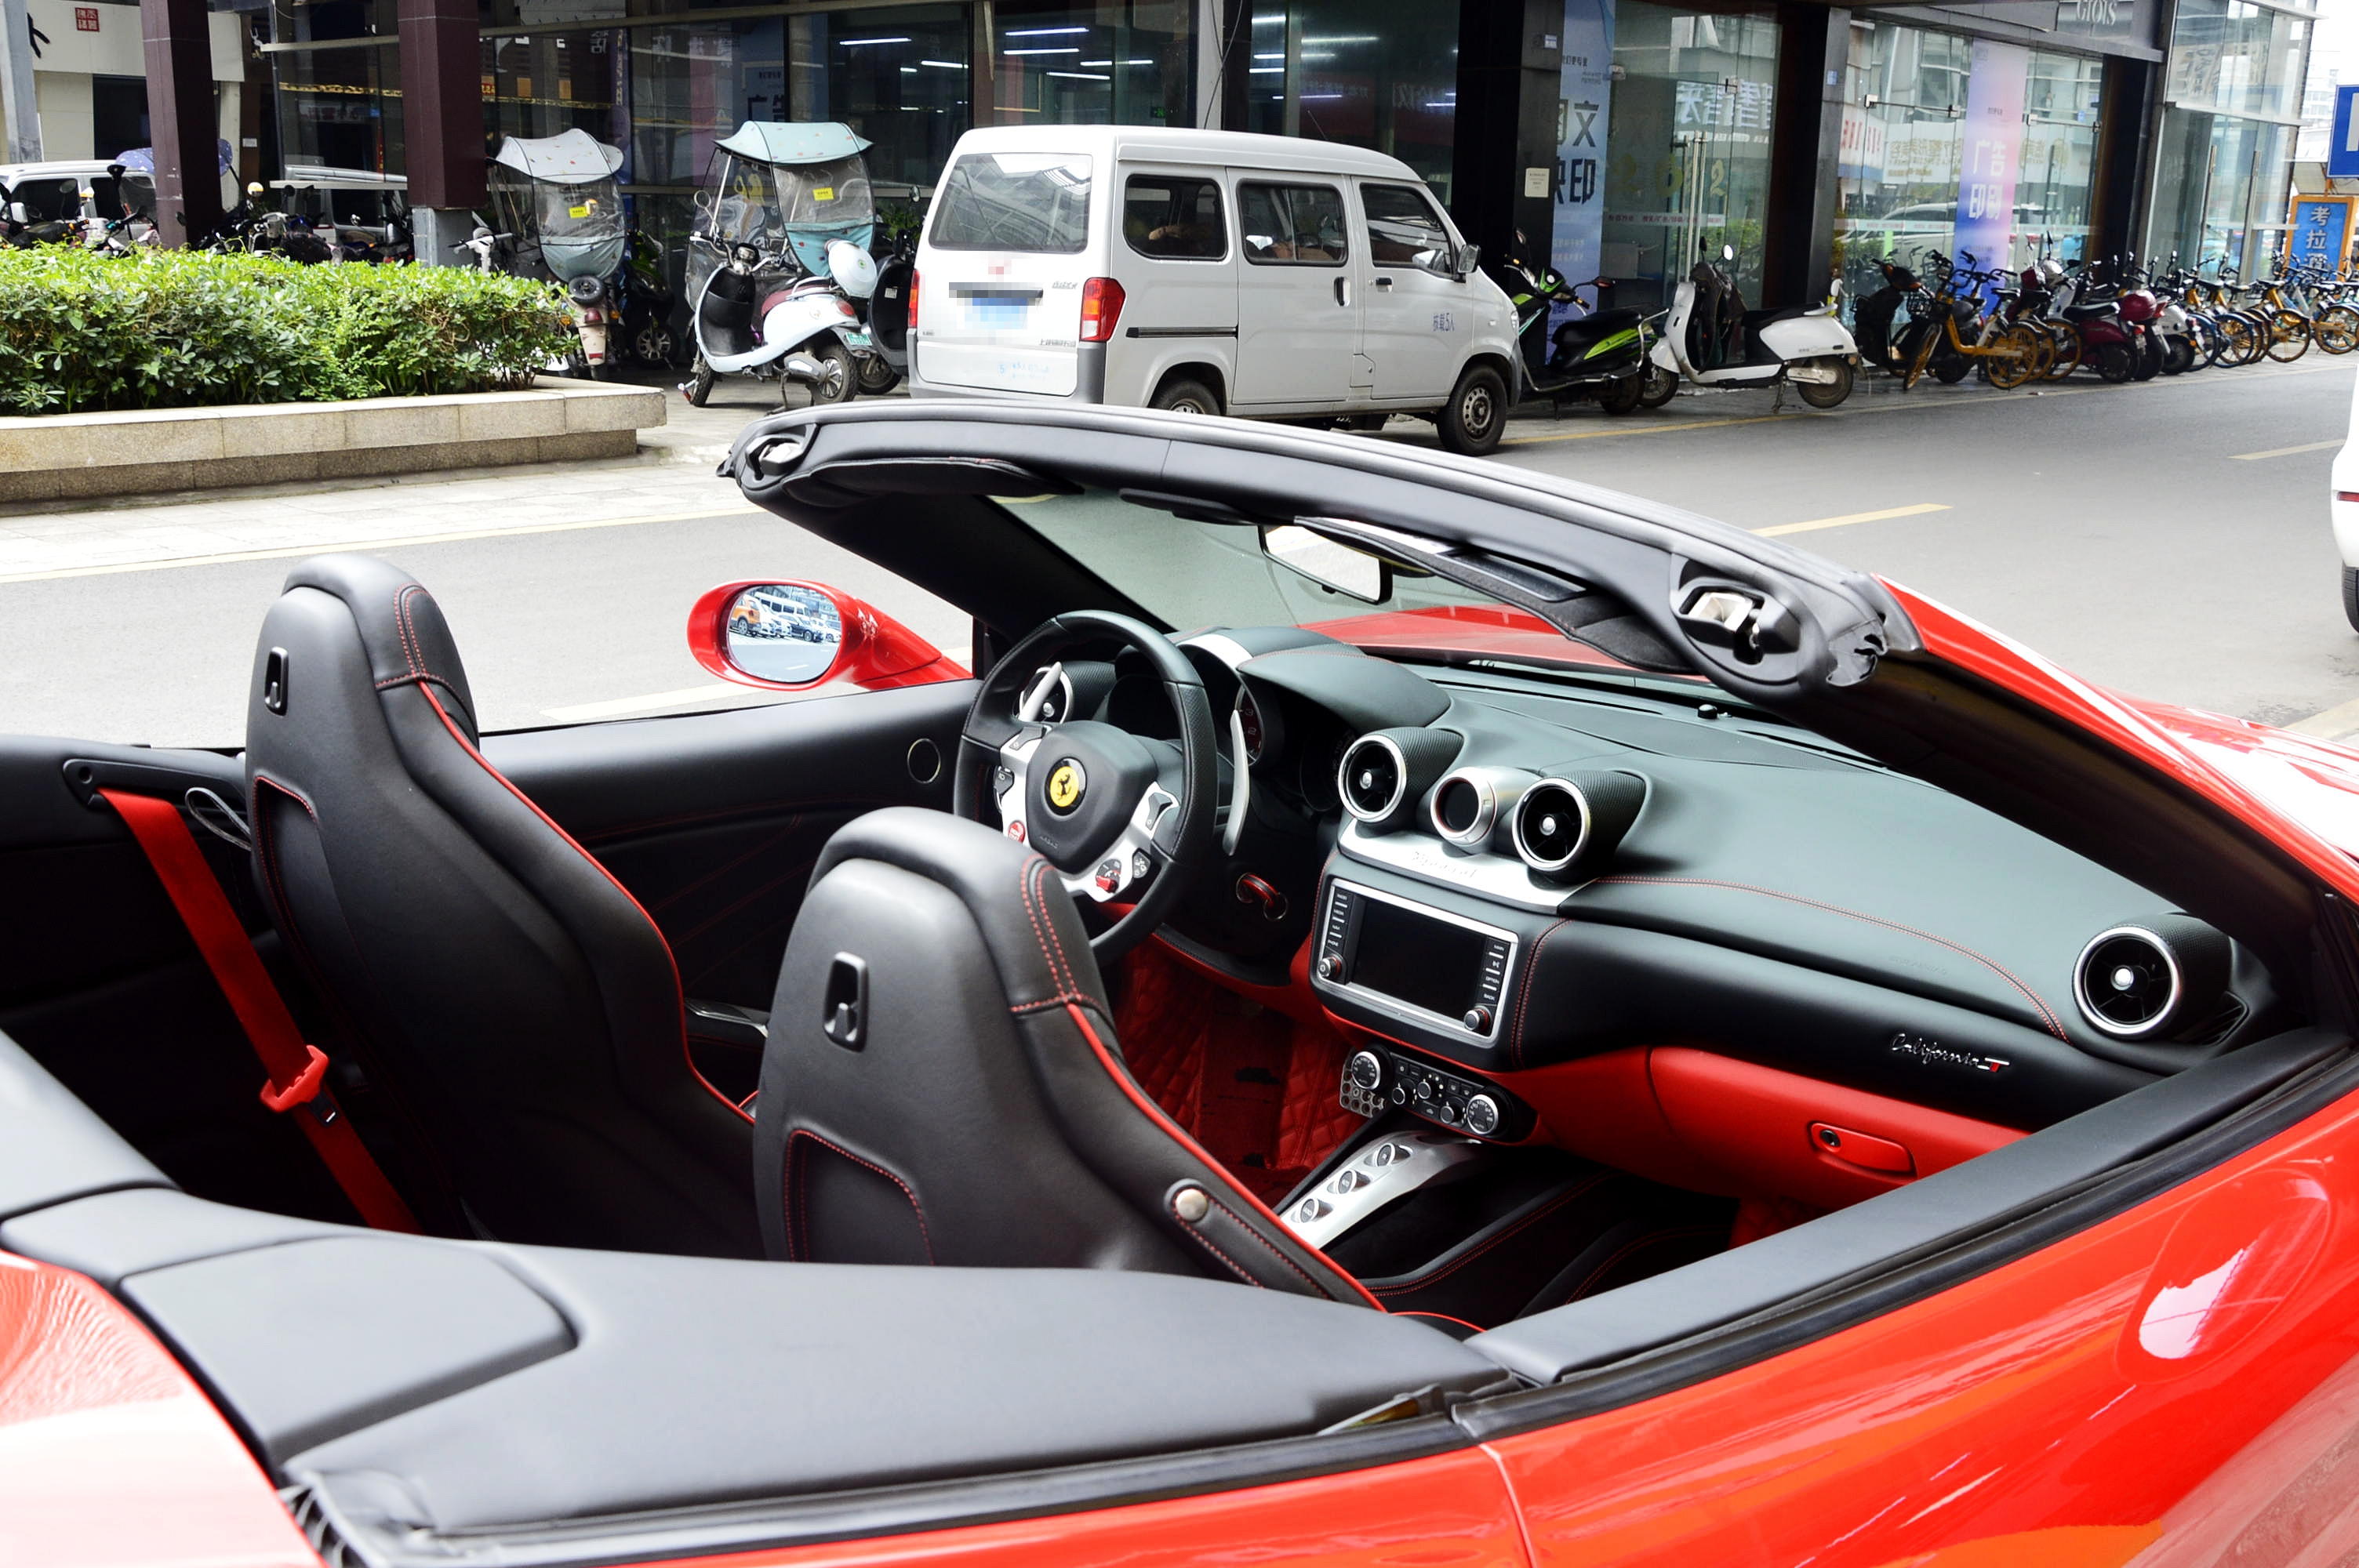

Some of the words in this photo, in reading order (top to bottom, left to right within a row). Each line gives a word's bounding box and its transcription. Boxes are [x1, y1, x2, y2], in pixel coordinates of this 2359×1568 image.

[1972, 140, 2006, 176] 广告
[1968, 183, 2003, 220] 印刷
[1892, 1033, 1980, 1065] California
[1984, 1057, 2010, 1073] T
